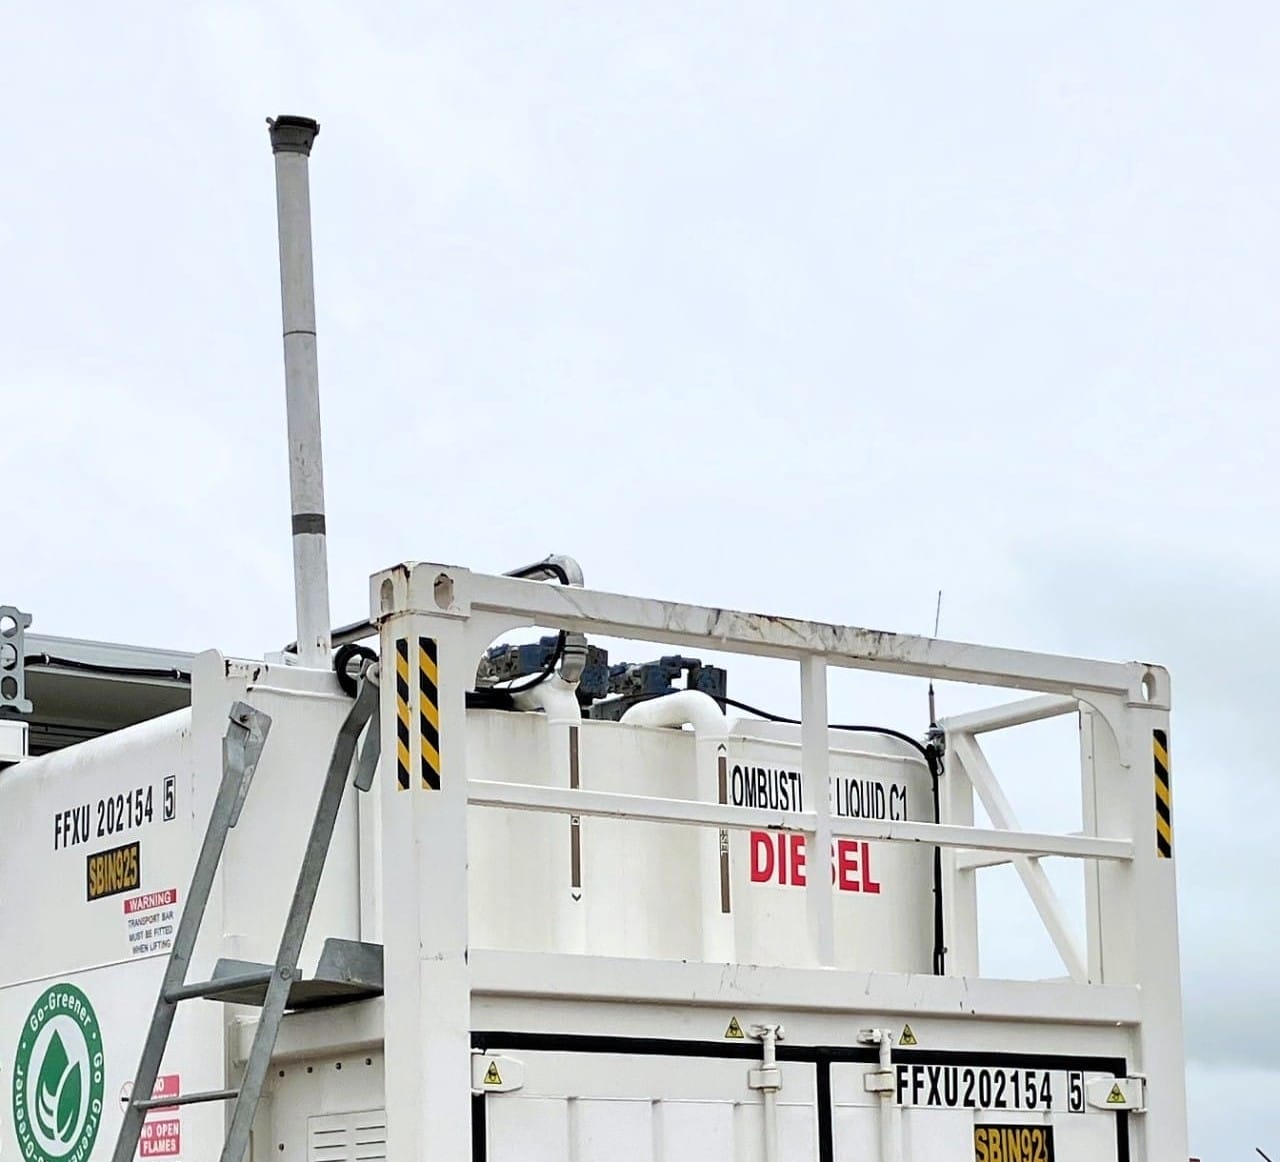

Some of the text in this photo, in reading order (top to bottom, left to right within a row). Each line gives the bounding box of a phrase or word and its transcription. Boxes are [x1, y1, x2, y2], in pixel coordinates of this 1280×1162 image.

[730, 764, 908, 822] OMBUSTI LIQUID C1
[54, 779, 174, 850] FFXU 202154 5
[89, 846, 138, 897] SBIN925
[750, 830, 881, 894] DIEEL
[129, 891, 172, 912] WARNING
[128, 913, 160, 927] TRANSPORT
[145, 929, 153, 939] BE
[30, 991, 93, 1032] Go-Greener
[92, 1051, 103, 1084] Go
[1069, 1072, 1082, 1111] 5
[143, 1138, 177, 1155] FLAMES
[156, 1122, 179, 1138] OPEN
